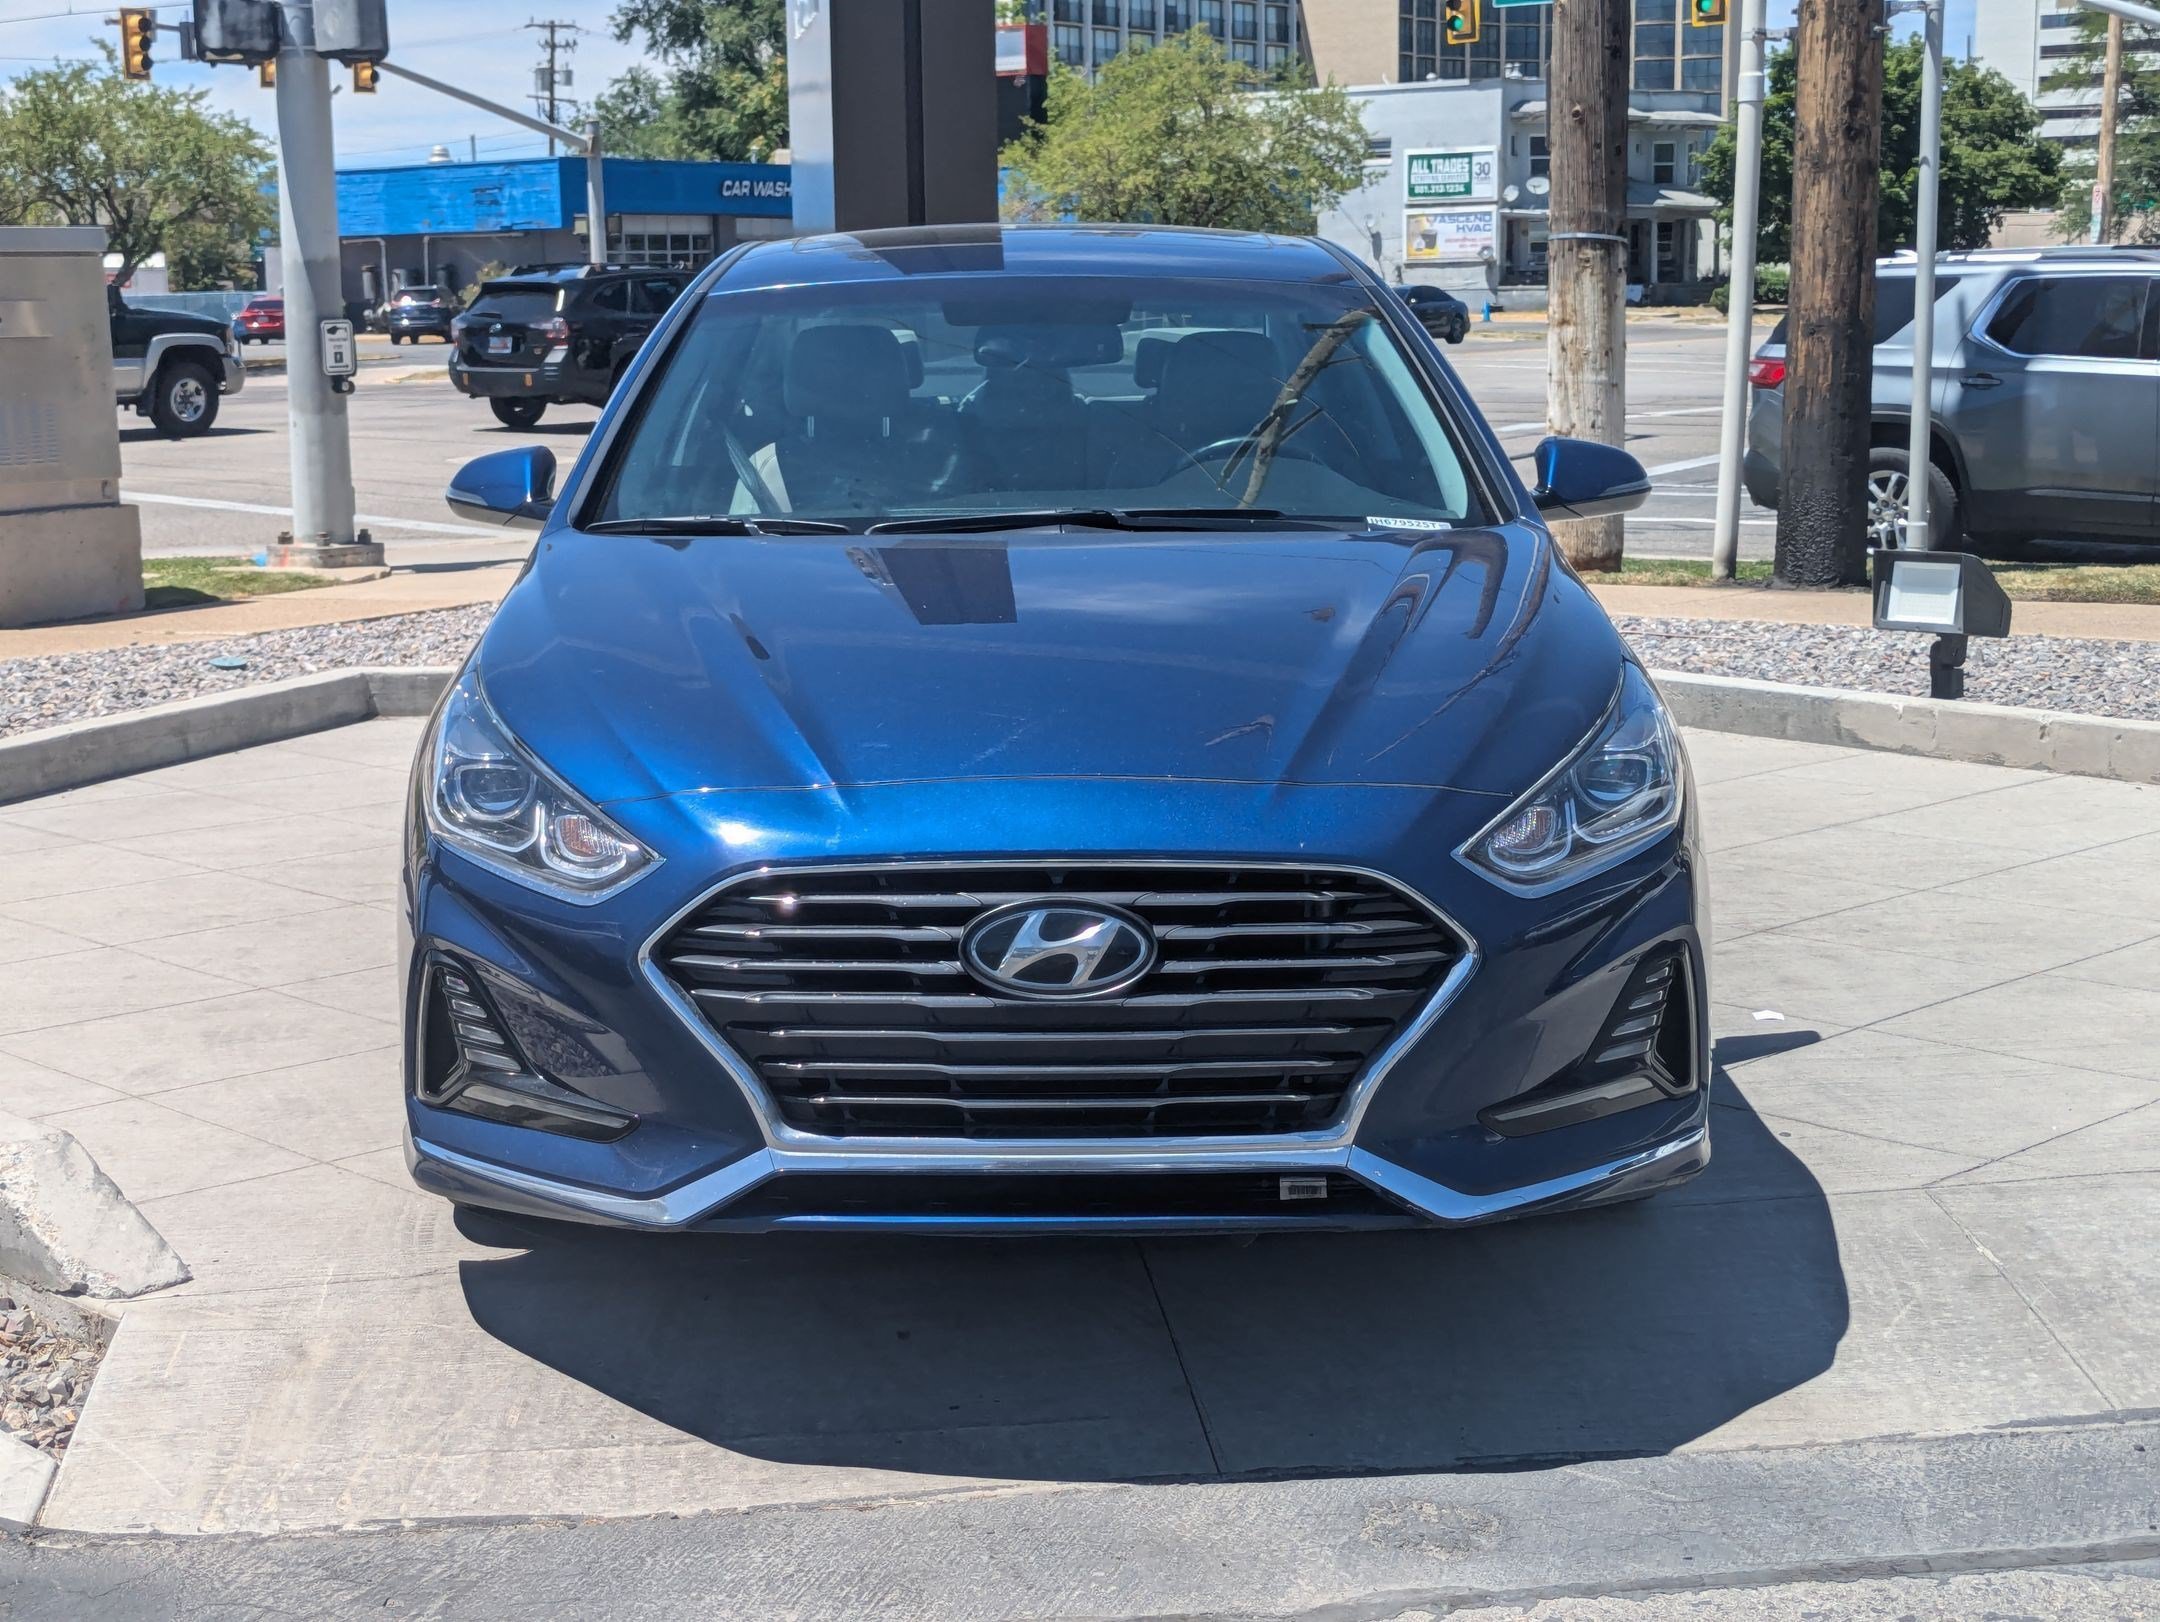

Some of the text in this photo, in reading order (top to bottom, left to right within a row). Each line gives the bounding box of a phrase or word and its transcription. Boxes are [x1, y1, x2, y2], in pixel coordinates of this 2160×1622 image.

[1411, 157, 1470, 173] ALL TRADES
[1474, 161, 1491, 176] 30
[722, 180, 793, 197] CAR WASH
[1438, 213, 1492, 224] ASCEND
[1456, 224, 1492, 233] HVAC
